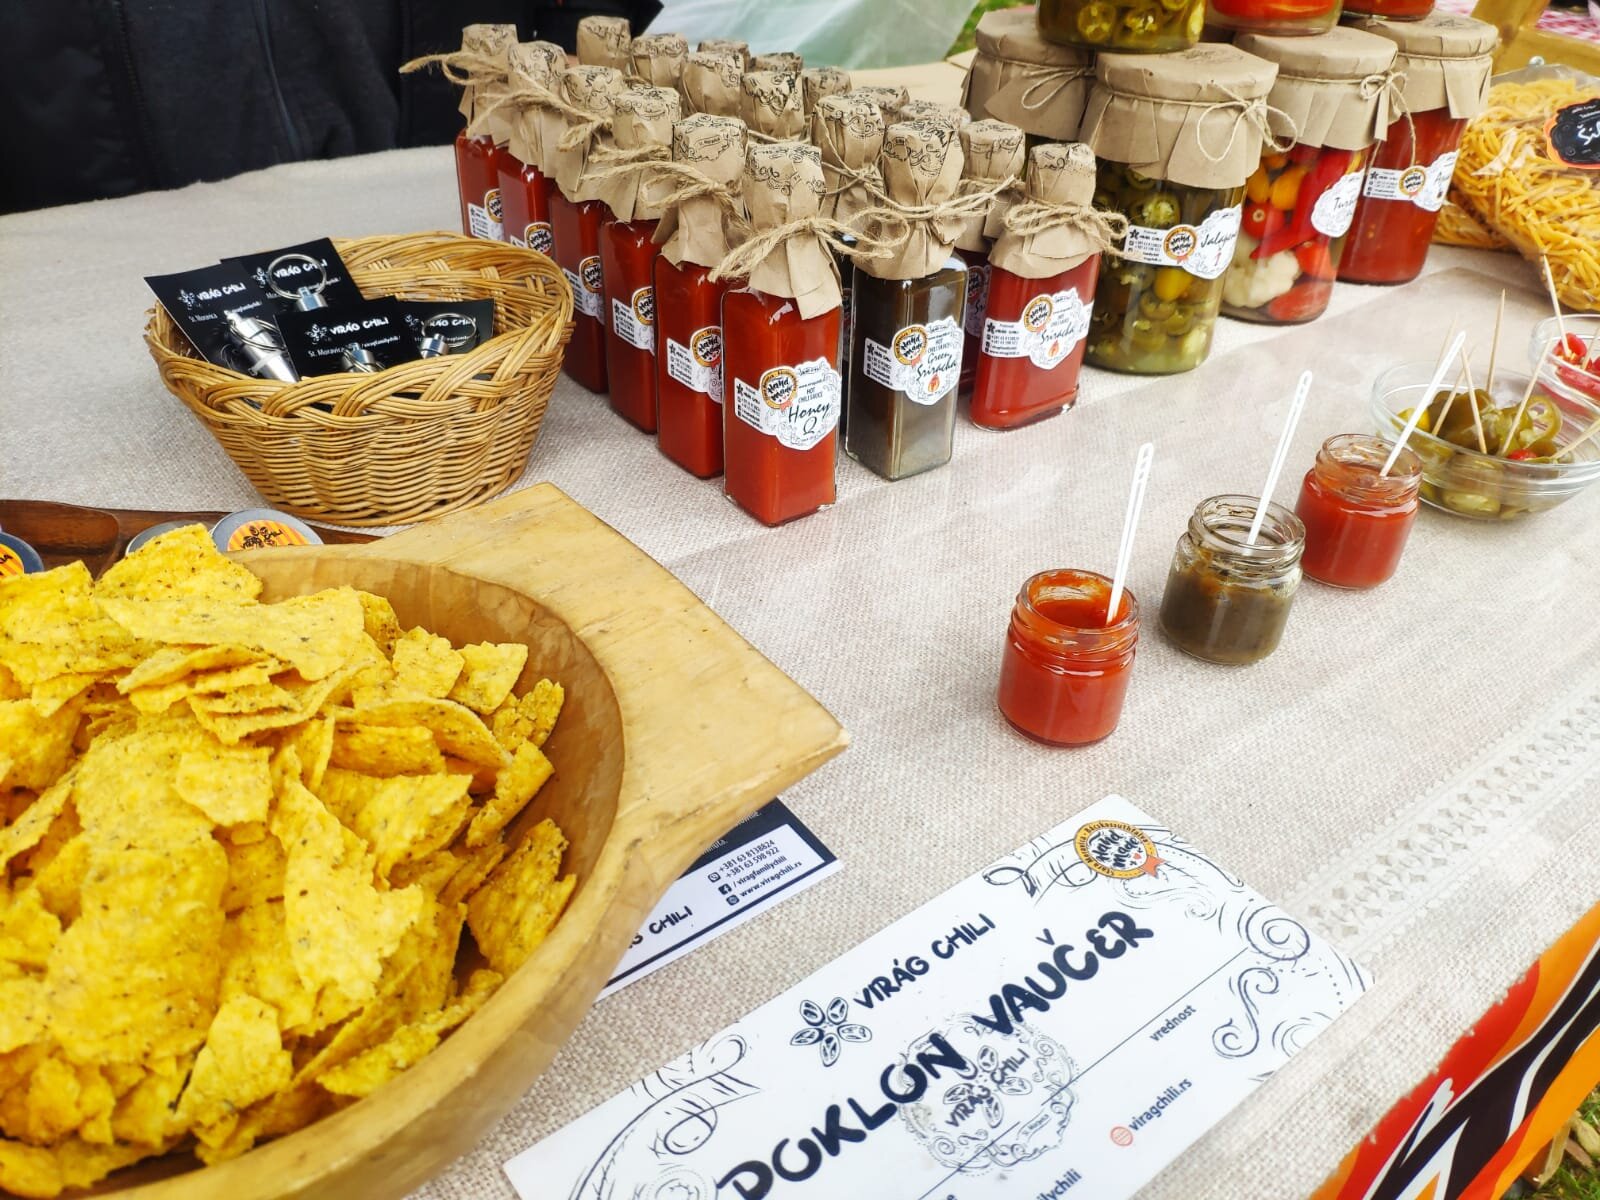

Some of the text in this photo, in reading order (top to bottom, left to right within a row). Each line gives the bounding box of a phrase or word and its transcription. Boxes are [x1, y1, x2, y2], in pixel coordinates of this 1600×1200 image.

[788, 402, 830, 423] Honey
[737, 854, 747, 863] 63
[744, 859, 754, 869] 63
[648, 905, 693, 934] CHILI
[853, 912, 996, 1010] VIRÁG CHILI
[1149, 1005, 1197, 1041] vrednost
[716, 911, 1154, 1200] DOKLON VAUČER
[1128, 1078, 1193, 1131] viragchili.rs
